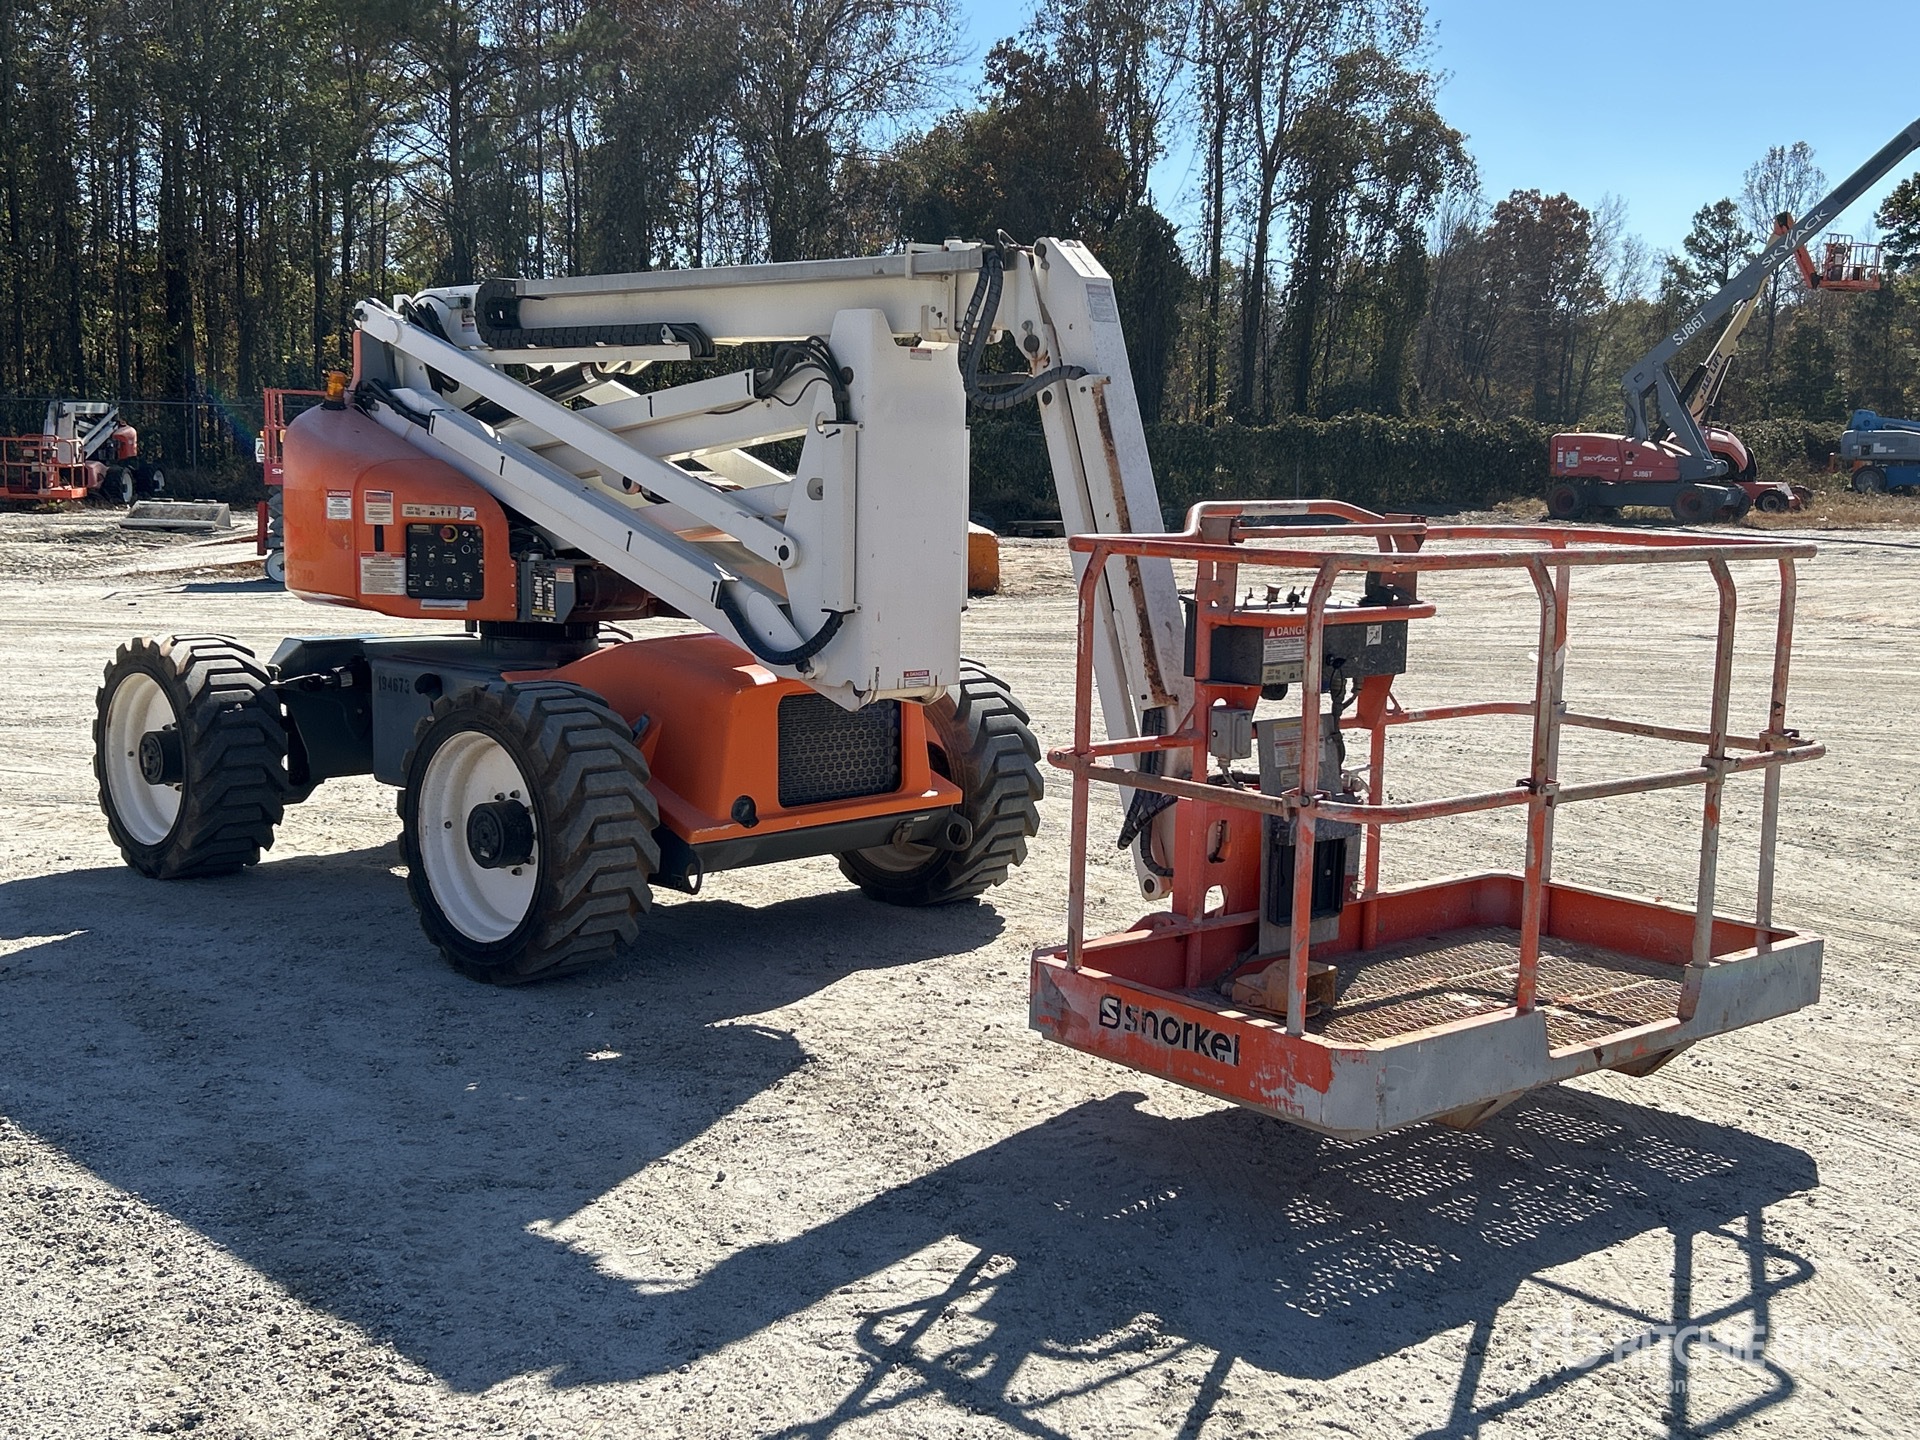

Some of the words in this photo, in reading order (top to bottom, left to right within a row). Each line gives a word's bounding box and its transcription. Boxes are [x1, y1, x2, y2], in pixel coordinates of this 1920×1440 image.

[1761, 209, 1829, 269] SKYJACK
[1672, 311, 1707, 346] SJ86T
[1701, 374, 1713, 395] JLG
[1710, 350, 1723, 374] LIFT
[1582, 454, 1618, 463] SKYJACK
[1276, 626, 1306, 636] DANGE
[378, 675, 410, 695] 194673
